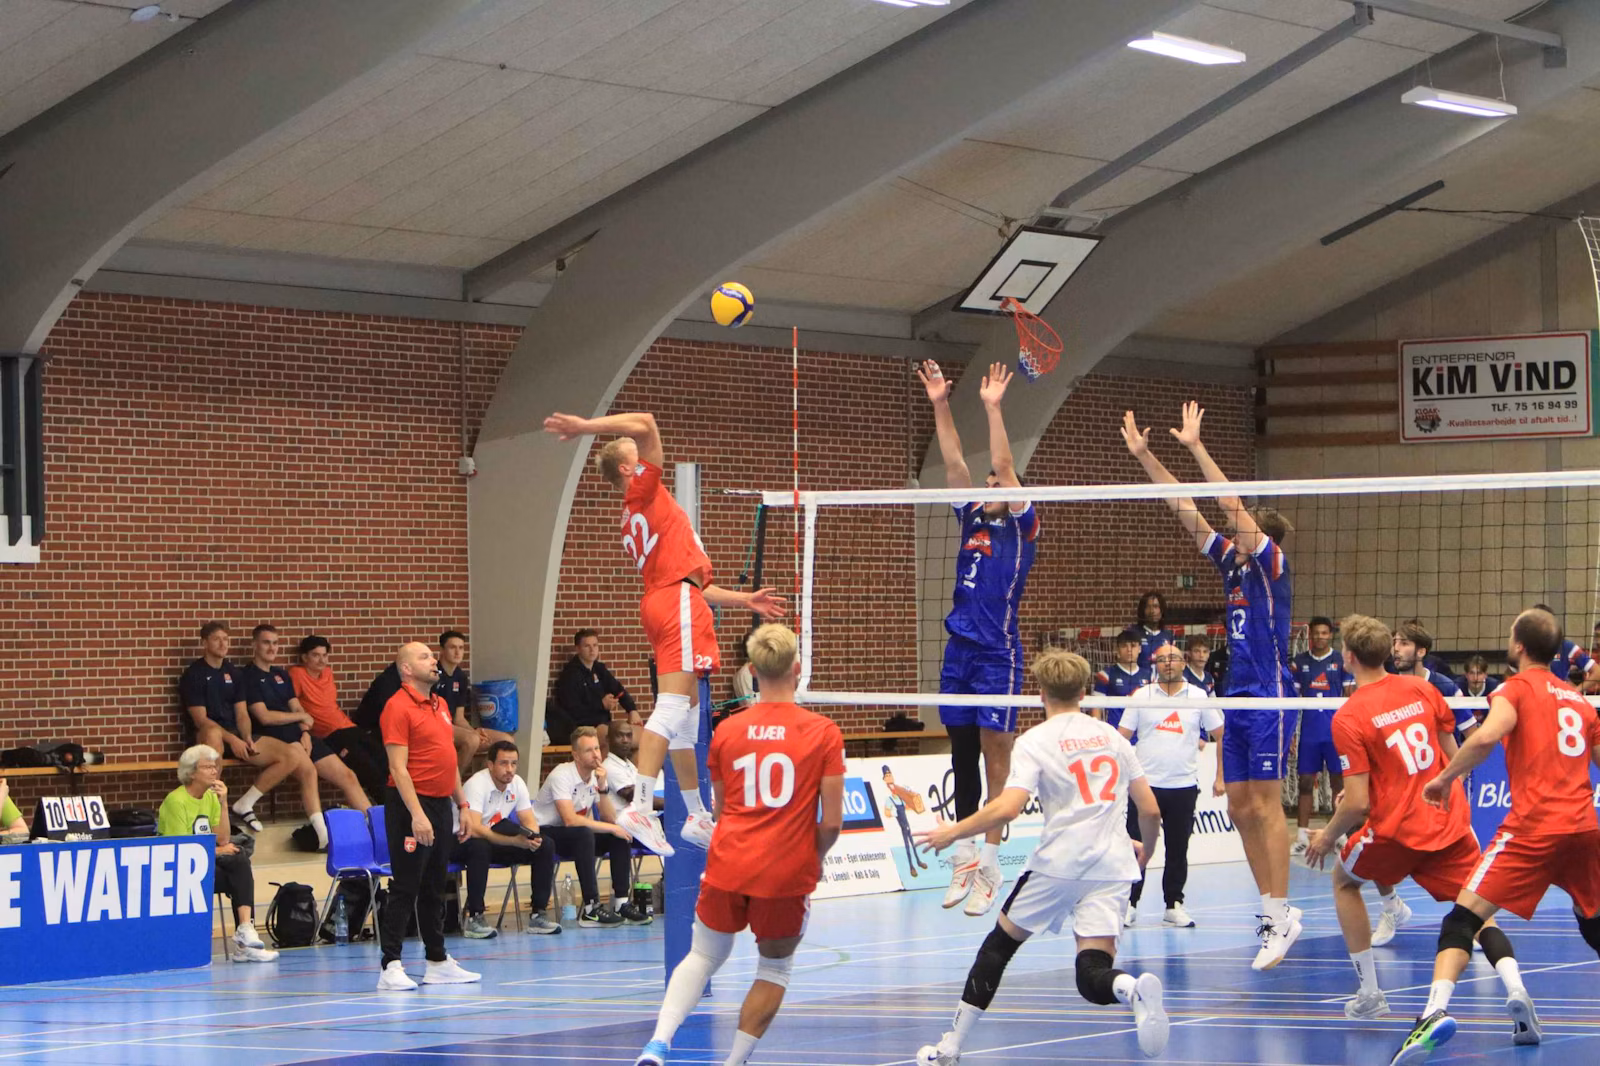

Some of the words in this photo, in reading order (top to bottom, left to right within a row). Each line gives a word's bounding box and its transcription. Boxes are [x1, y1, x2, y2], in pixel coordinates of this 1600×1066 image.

[1412, 351, 1516, 365] ENTREPRENØR
[1491, 403, 1511, 412] TLF.
[1515, 402, 1528, 411] 75
[1532, 401, 1544, 410] 16
[1547, 400, 1561, 410] 94
[1564, 400, 1578, 409] 99
[1519, 417, 1528, 425] til
[1530, 415, 1554, 424] aftalt
[694, 654, 713, 669] 22
[1371, 701, 1424, 728] UHRENHOLT
[747, 725, 785, 740] KJÆR
[1557, 707, 1585, 756] 8
[1385, 722, 1434, 775] 18
[733, 752, 795, 808] 10
[1068, 755, 1118, 805] 12
[46, 801, 64, 828] 10
[67, 803, 74, 819] 1
[77, 802, 85, 820] 1
[90, 801, 104, 826] 8
[38, 842, 209, 925] WATER
